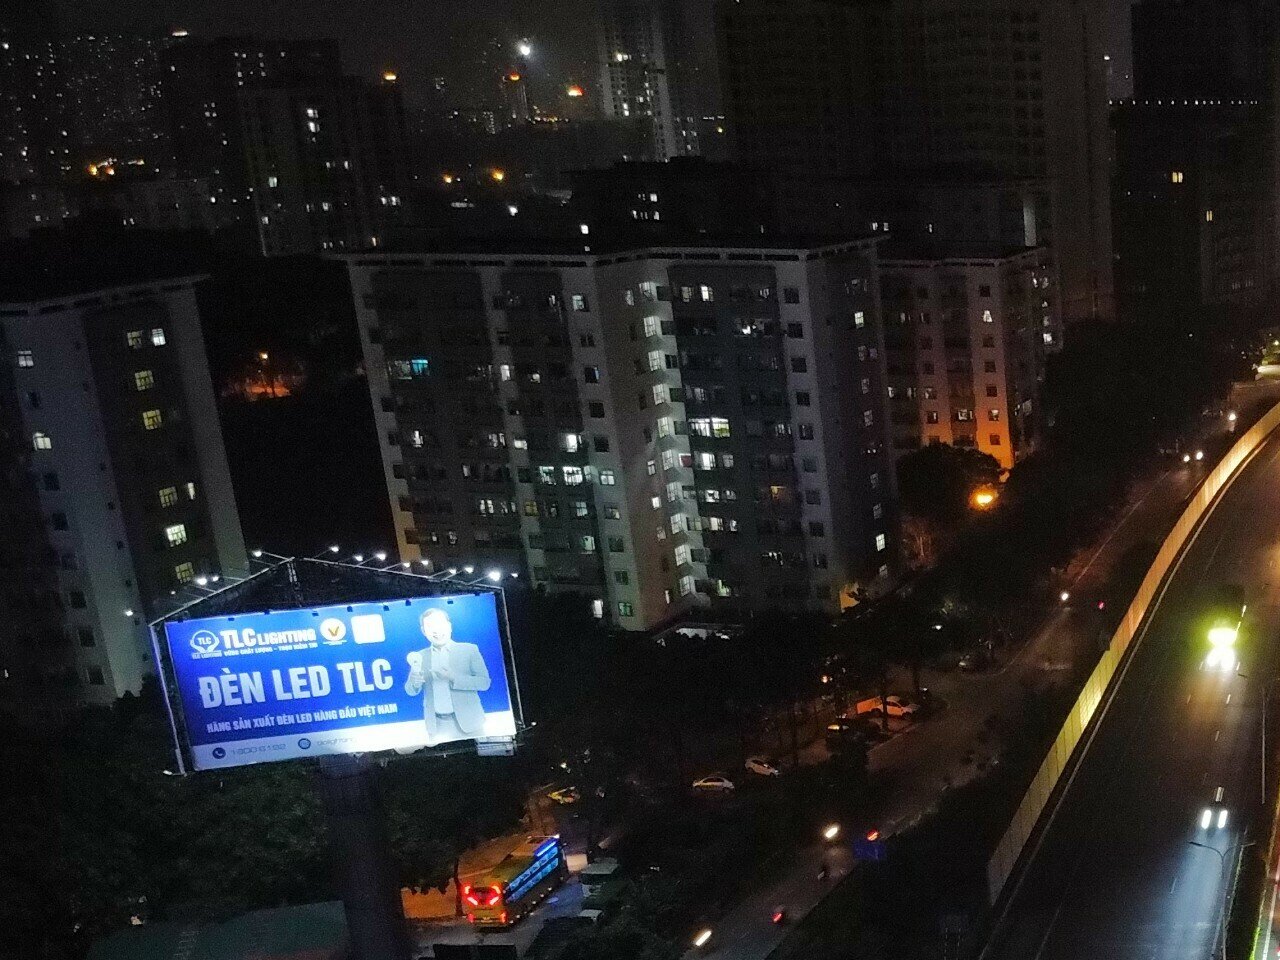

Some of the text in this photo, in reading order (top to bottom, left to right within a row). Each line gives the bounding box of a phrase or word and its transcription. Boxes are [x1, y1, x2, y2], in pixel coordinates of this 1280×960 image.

[198, 637, 211, 645] TLC
[220, 628, 257, 649] TLC
[198, 658, 394, 709] ĐÈN LED TLC
[253, 713, 277, 728] XUẤT
[296, 713, 312, 724] LED
[313, 708, 338, 722] HÀNG
[357, 705, 377, 718] VIỆT
[377, 703, 398, 714] NAM
